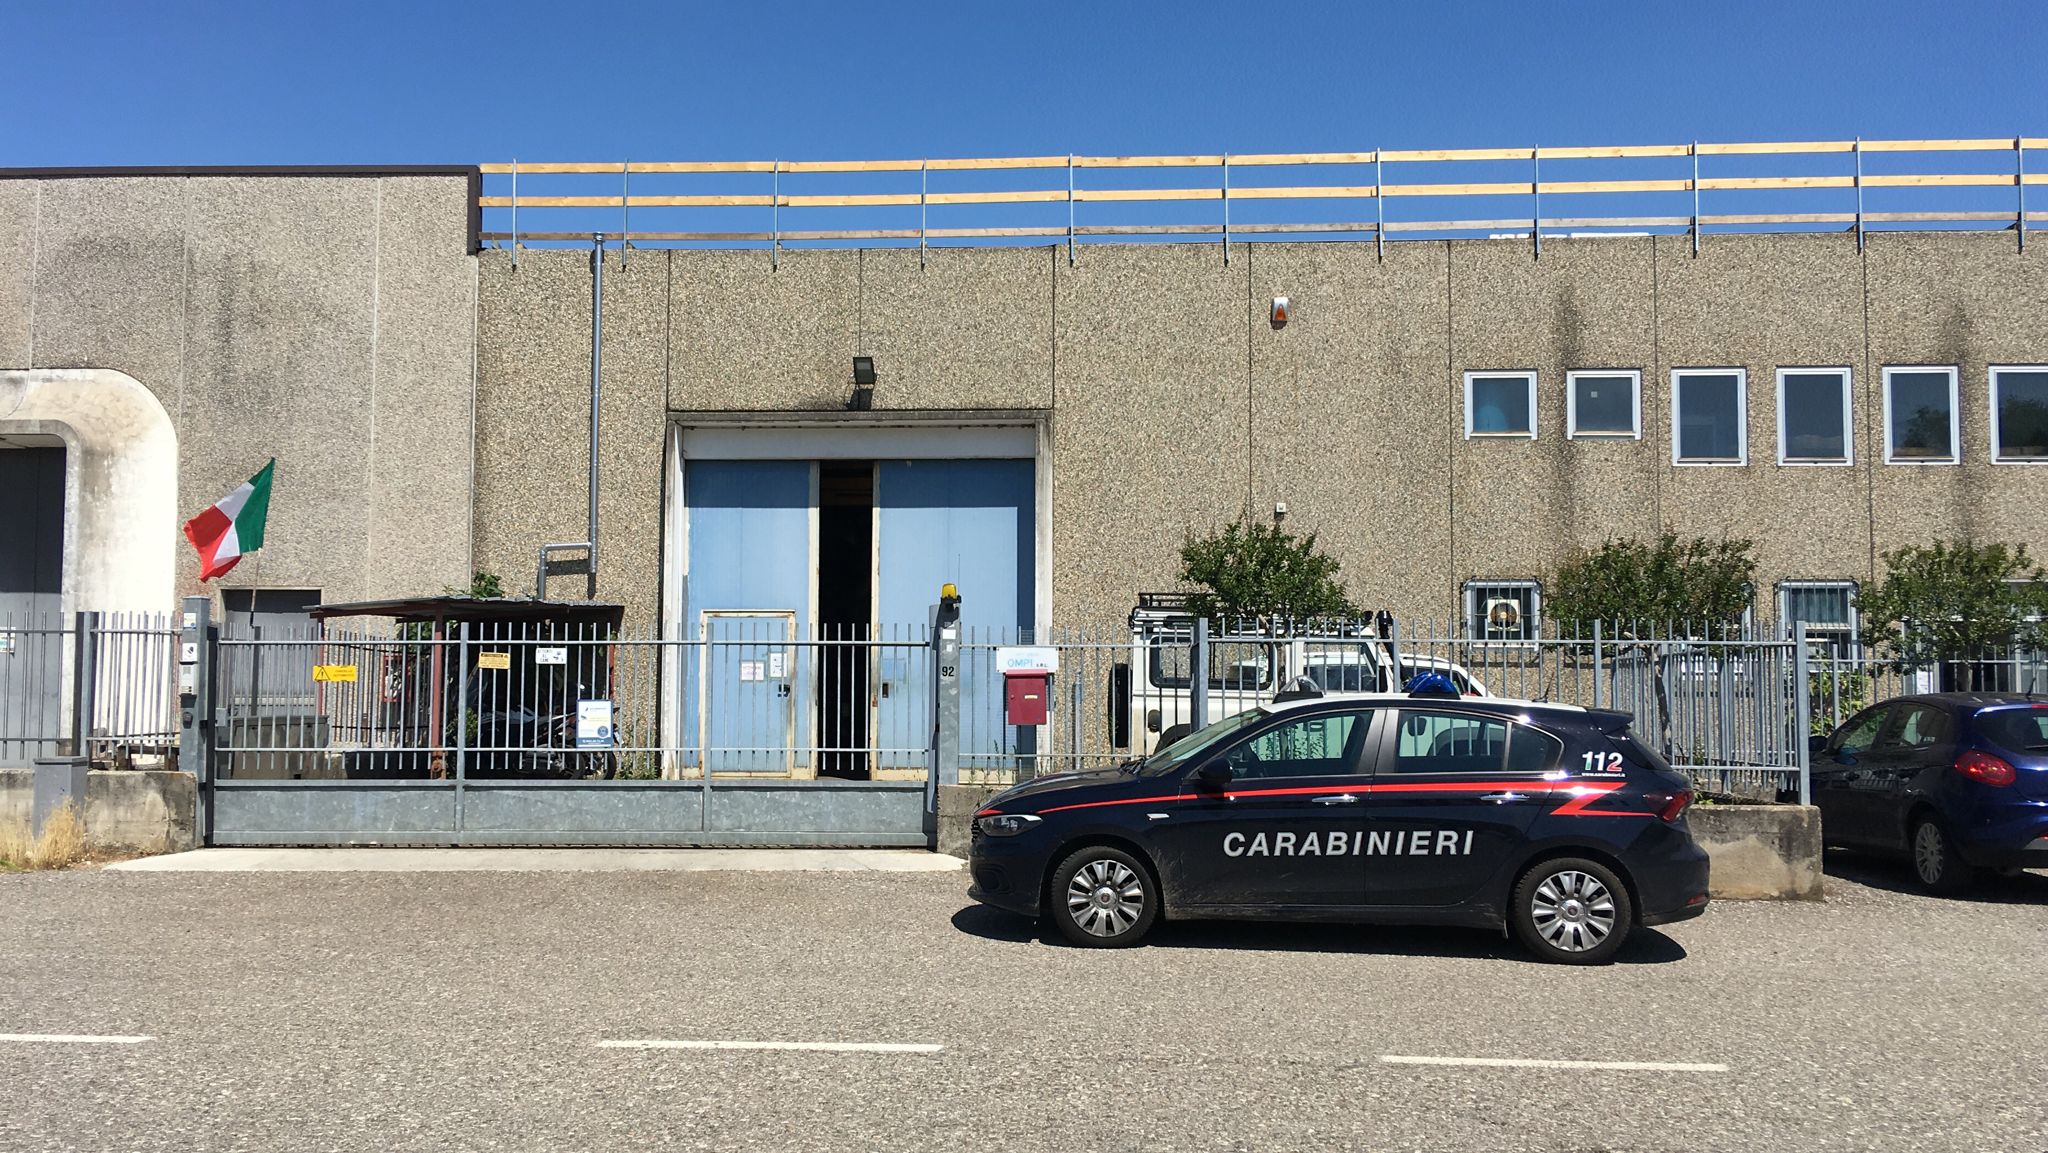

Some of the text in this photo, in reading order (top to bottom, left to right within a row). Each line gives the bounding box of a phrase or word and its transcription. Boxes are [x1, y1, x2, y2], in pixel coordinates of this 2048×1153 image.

[1007, 658, 1033, 667] OMPI
[942, 666, 954, 677] 92
[1582, 751, 1623, 772] 112
[1223, 830, 1474, 857] CARABINIERI
